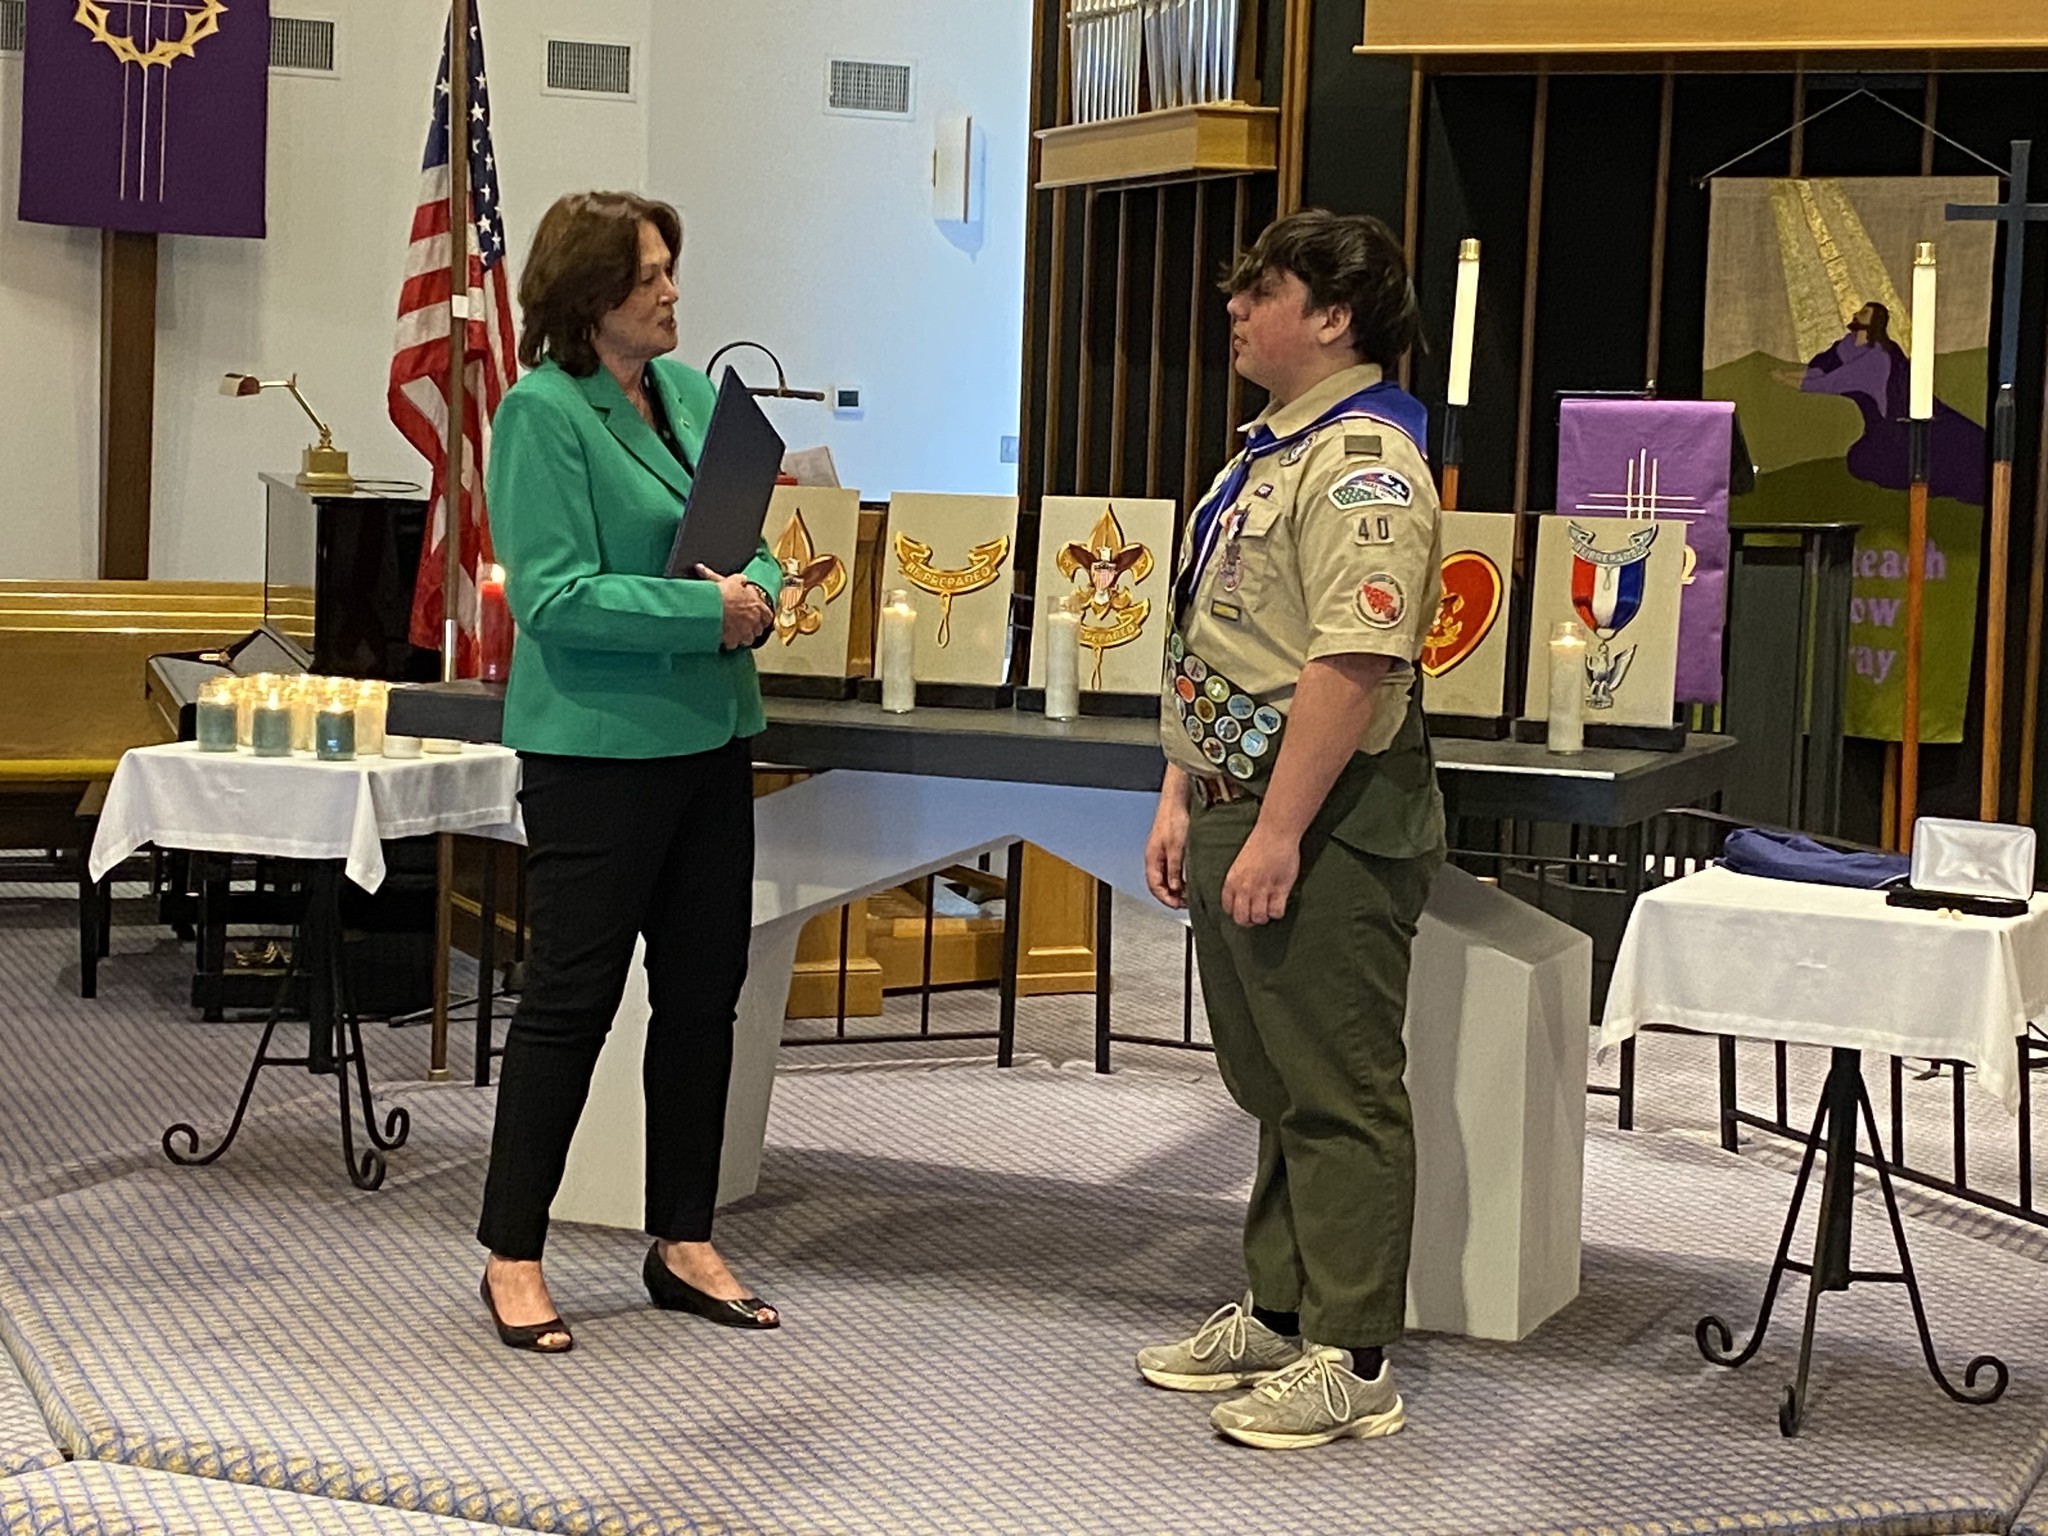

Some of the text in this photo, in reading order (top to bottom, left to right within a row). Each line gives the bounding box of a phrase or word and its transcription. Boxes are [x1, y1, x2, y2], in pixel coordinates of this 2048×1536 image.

[1358, 517, 1390, 541] 40
[922, 567, 991, 588] PREPARED
[1850, 597, 1900, 626] ow
